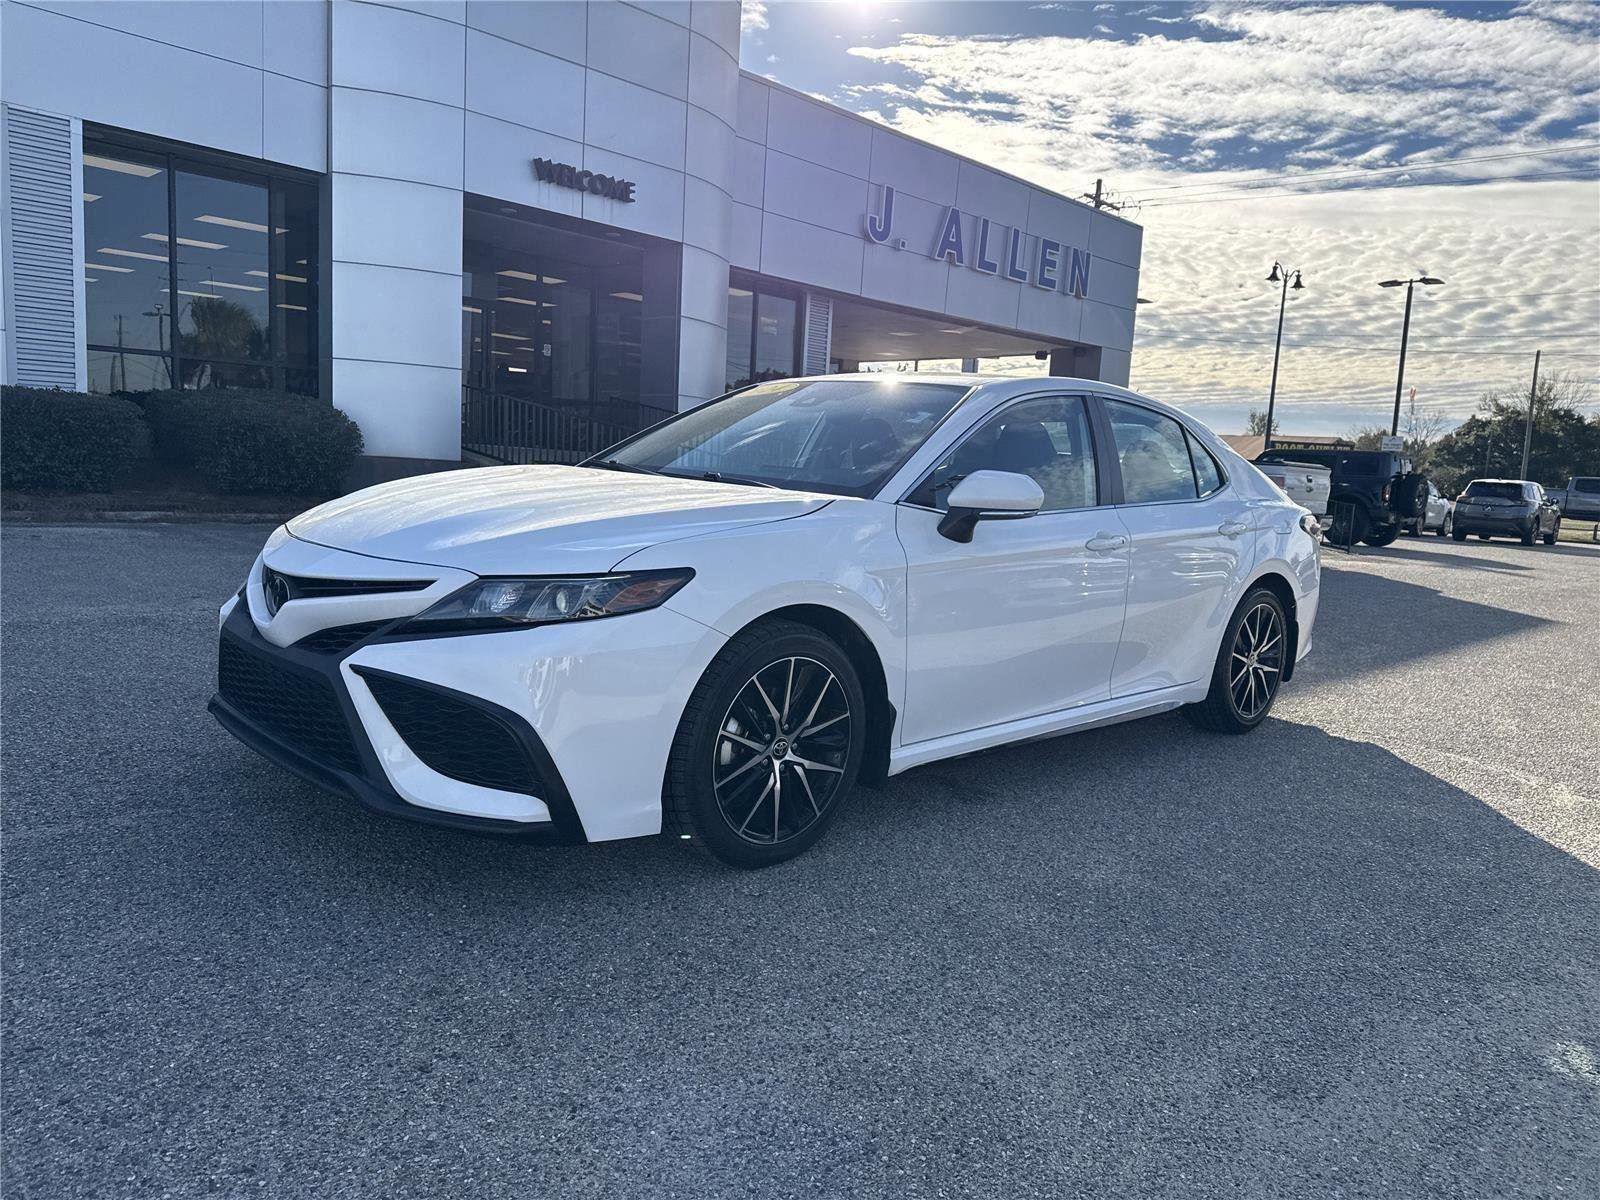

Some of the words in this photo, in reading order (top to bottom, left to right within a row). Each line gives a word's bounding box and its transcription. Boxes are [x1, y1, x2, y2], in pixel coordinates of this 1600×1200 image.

[533, 157, 636, 203] WELCOME
[865, 184, 907, 250] J.
[934, 206, 1092, 298] ALLEN
